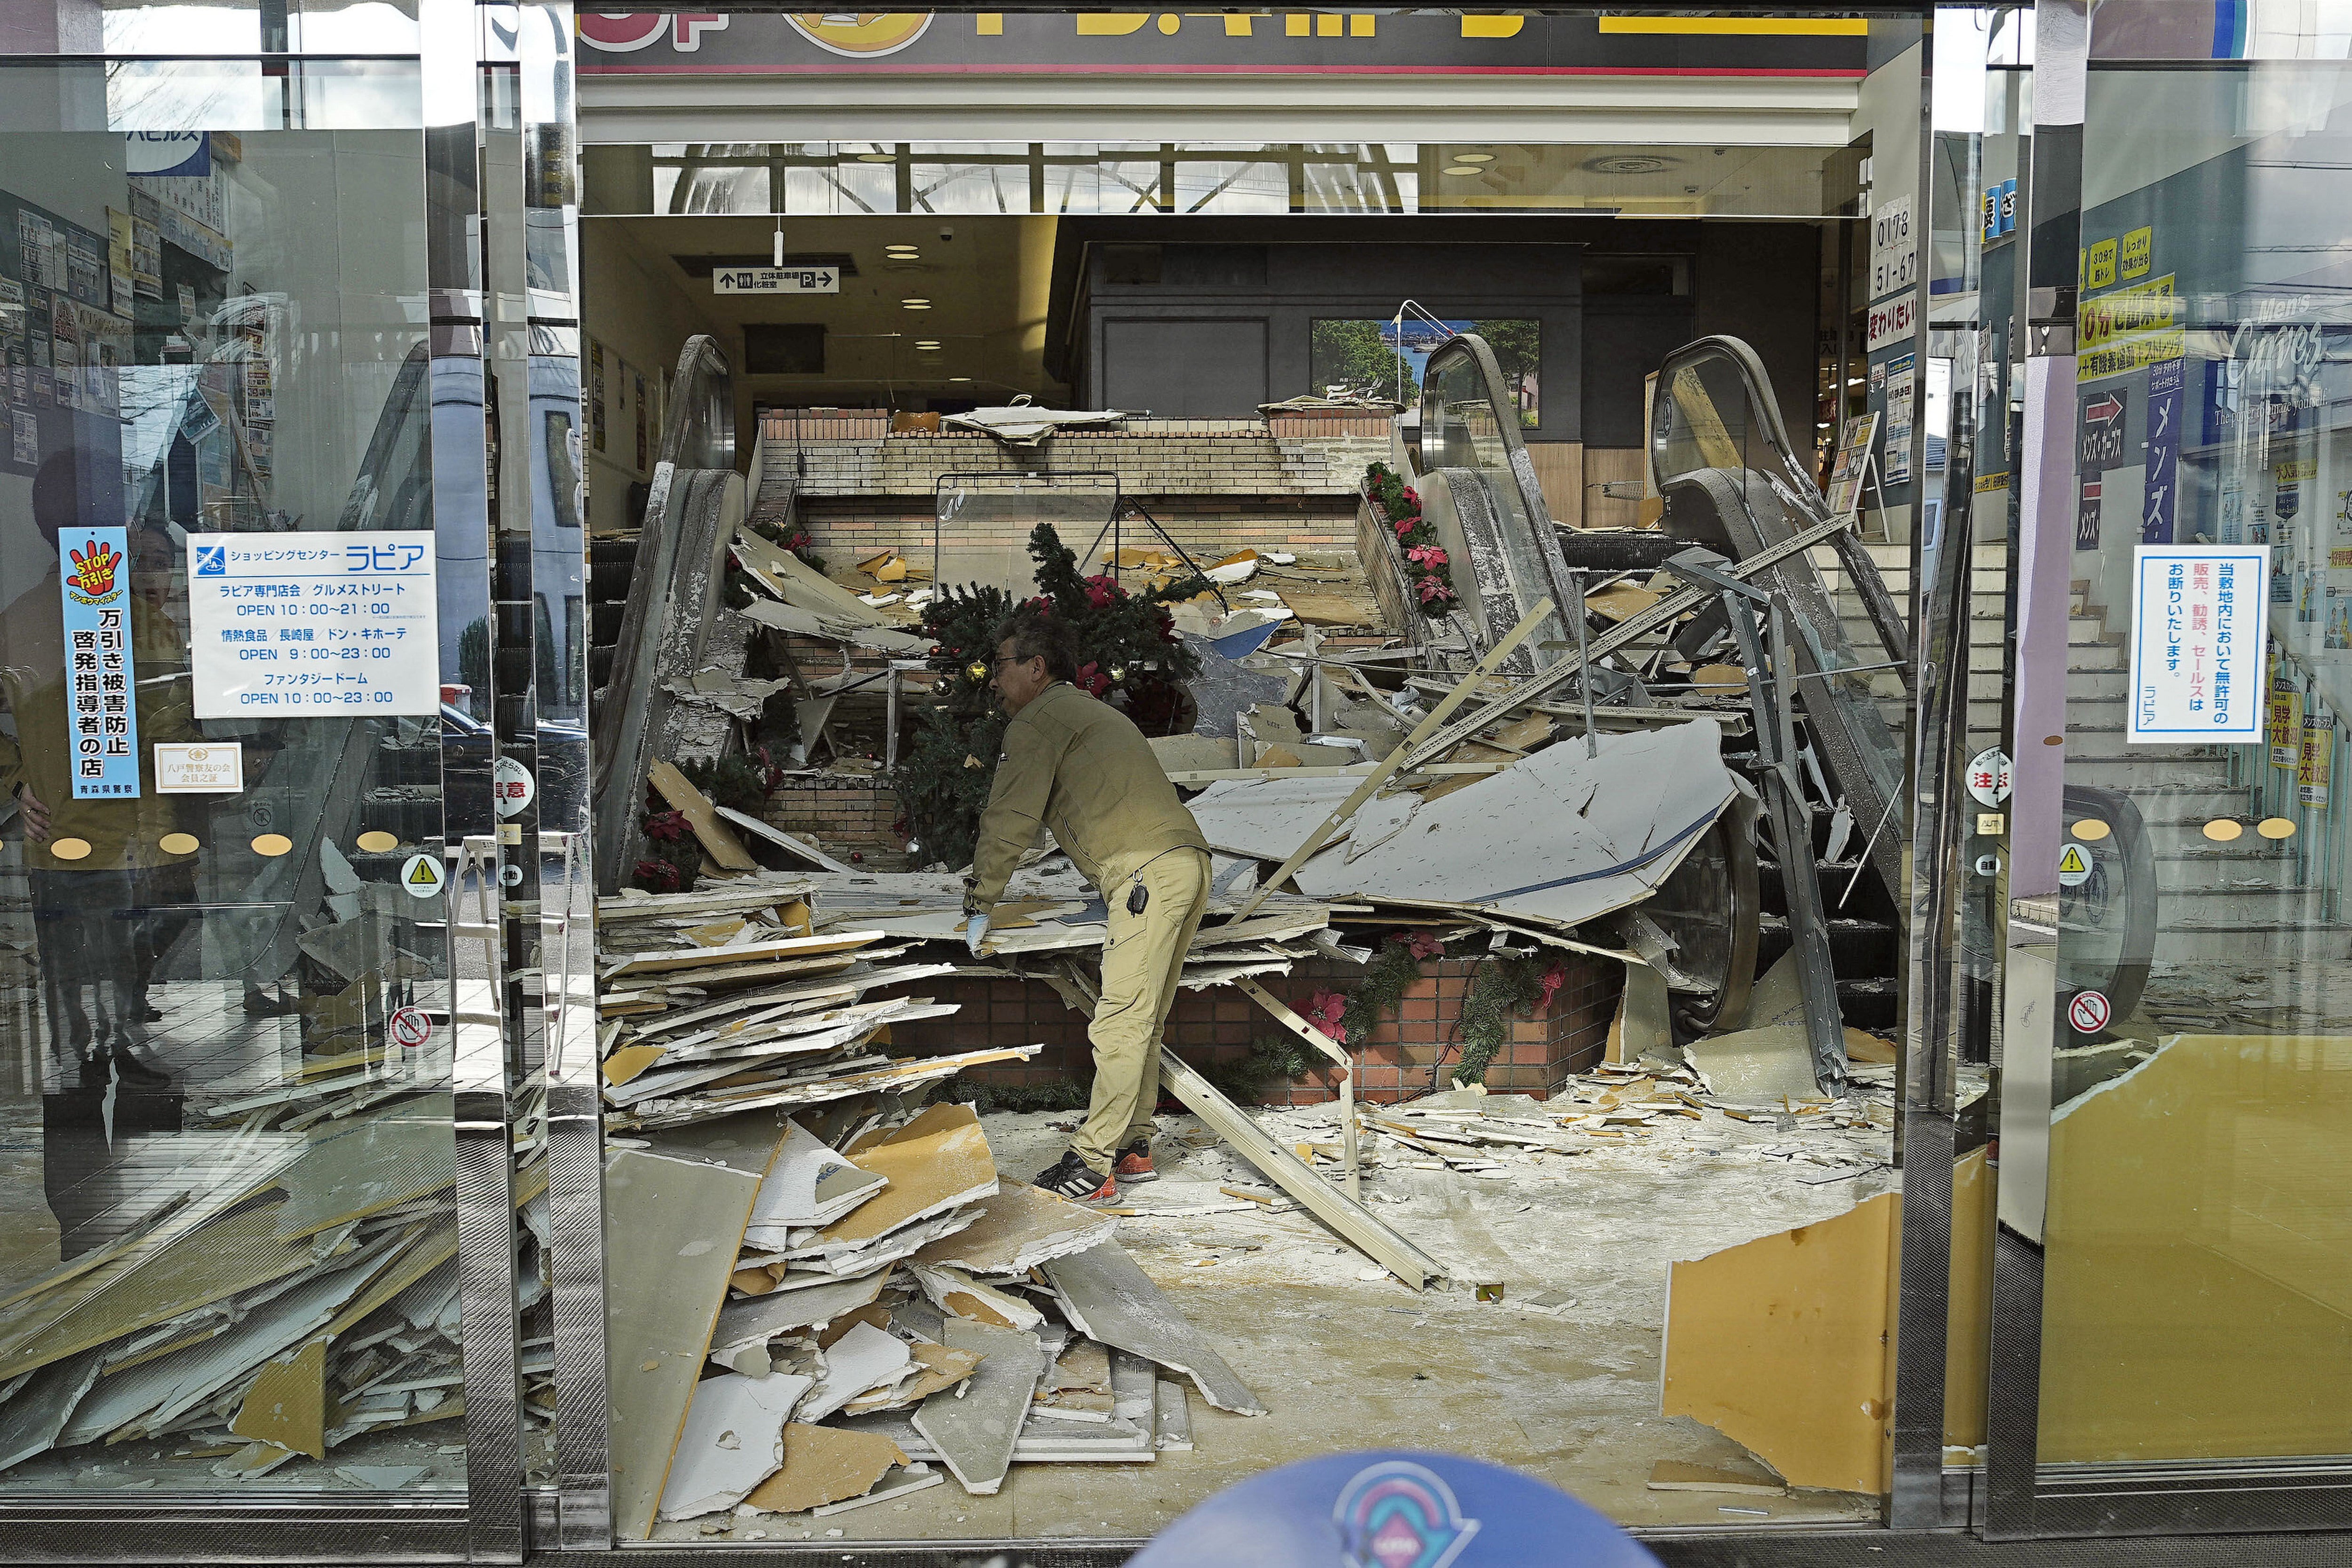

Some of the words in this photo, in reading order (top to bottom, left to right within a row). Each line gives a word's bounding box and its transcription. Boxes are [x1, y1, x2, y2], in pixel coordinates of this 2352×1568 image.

[1878, 210, 1908, 247] 0178
[1877, 250, 1918, 291] 51-67
[2093, 248, 2114, 265] 30分で
[1868, 299, 1917, 341] 変わりたい
[2078, 284, 2171, 341] 0分で出来る
[2258, 294, 2311, 324] Men's
[2226, 317, 2322, 385] Curves
[2215, 409, 2229, 426] The
[2232, 407, 2255, 428] power
[76, 553, 110, 575] STOP
[230, 550, 340, 561] ショッピングセンター
[346, 544, 424, 571] ラピア
[77, 567, 114, 590] 万引き
[237, 604, 275, 616] OPEN
[2166, 563, 2184, 677] お断りいたします。
[239, 649, 278, 660] OPEN
[2214, 563, 2234, 724] 当敷地内において無許可の
[99, 610, 129, 754] 万引き被害防止
[264, 672, 368, 686] ファンタジードーム
[73, 632, 103, 776] 啓発指導者の店
[241, 693, 278, 704] OPEN
[2144, 686, 2156, 726] ラピア
[2274, 705, 2290, 723] 見学
[80, 784, 133, 794] 青森県警察
